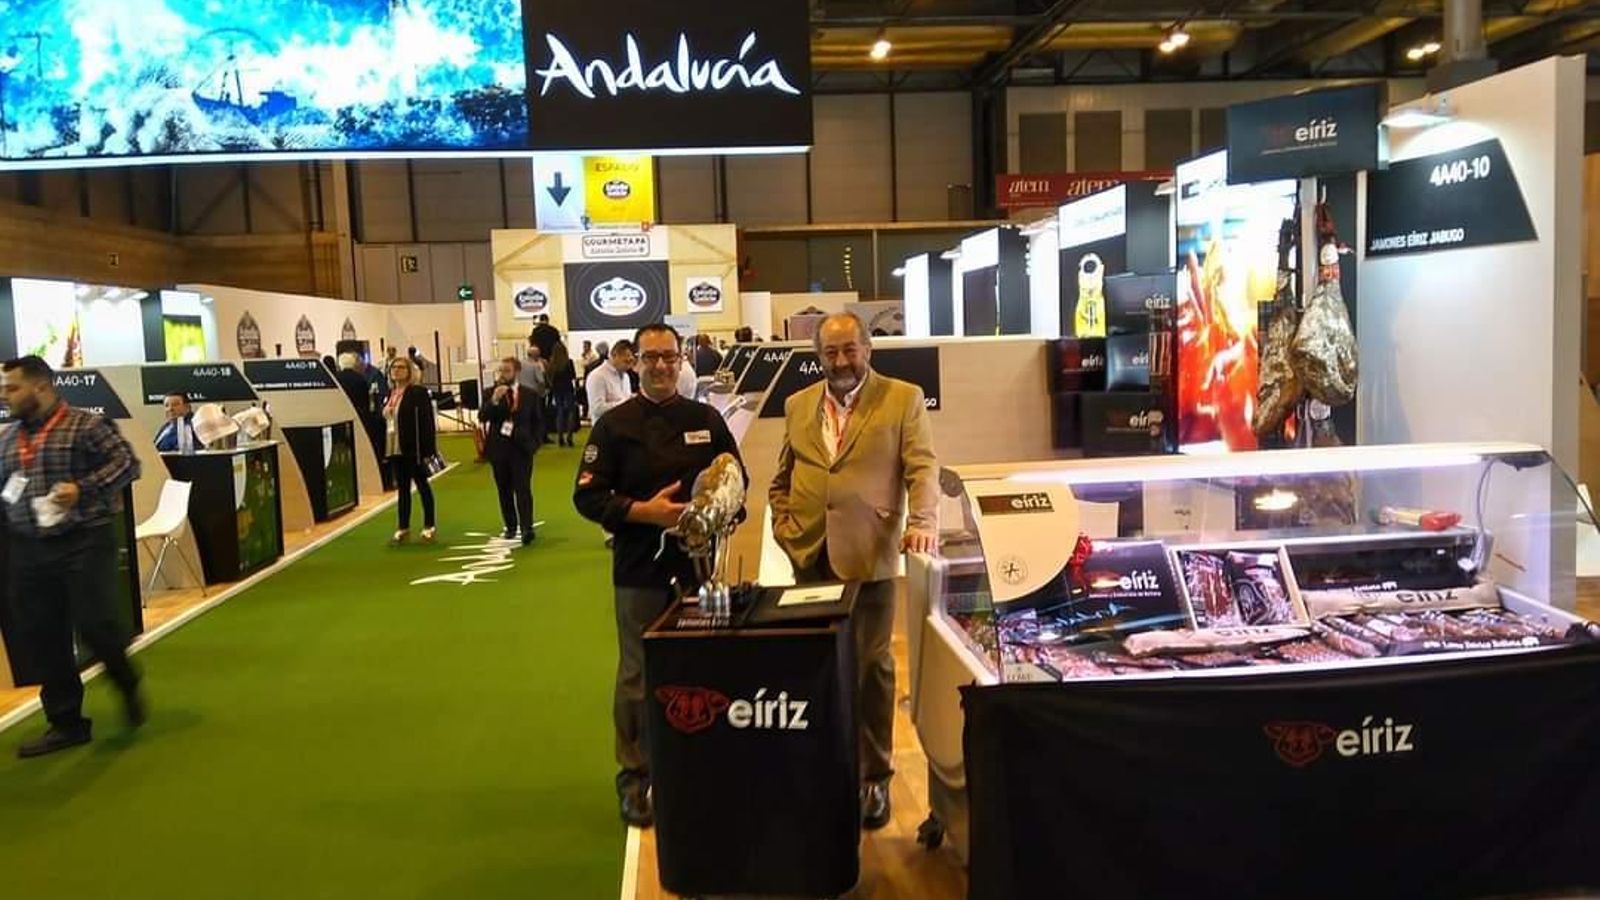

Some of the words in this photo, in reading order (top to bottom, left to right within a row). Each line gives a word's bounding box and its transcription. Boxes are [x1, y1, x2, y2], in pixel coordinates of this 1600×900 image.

[534, 31, 801, 99] Andalucía
[1295, 119, 1337, 141] eíriz
[1429, 155, 1491, 187] 4A40-10
[53, 375, 96, 387] A40-17
[1120, 569, 1159, 590] eíriz
[728, 687, 809, 730] eíriz
[1336, 716, 1413, 756] eíriz
